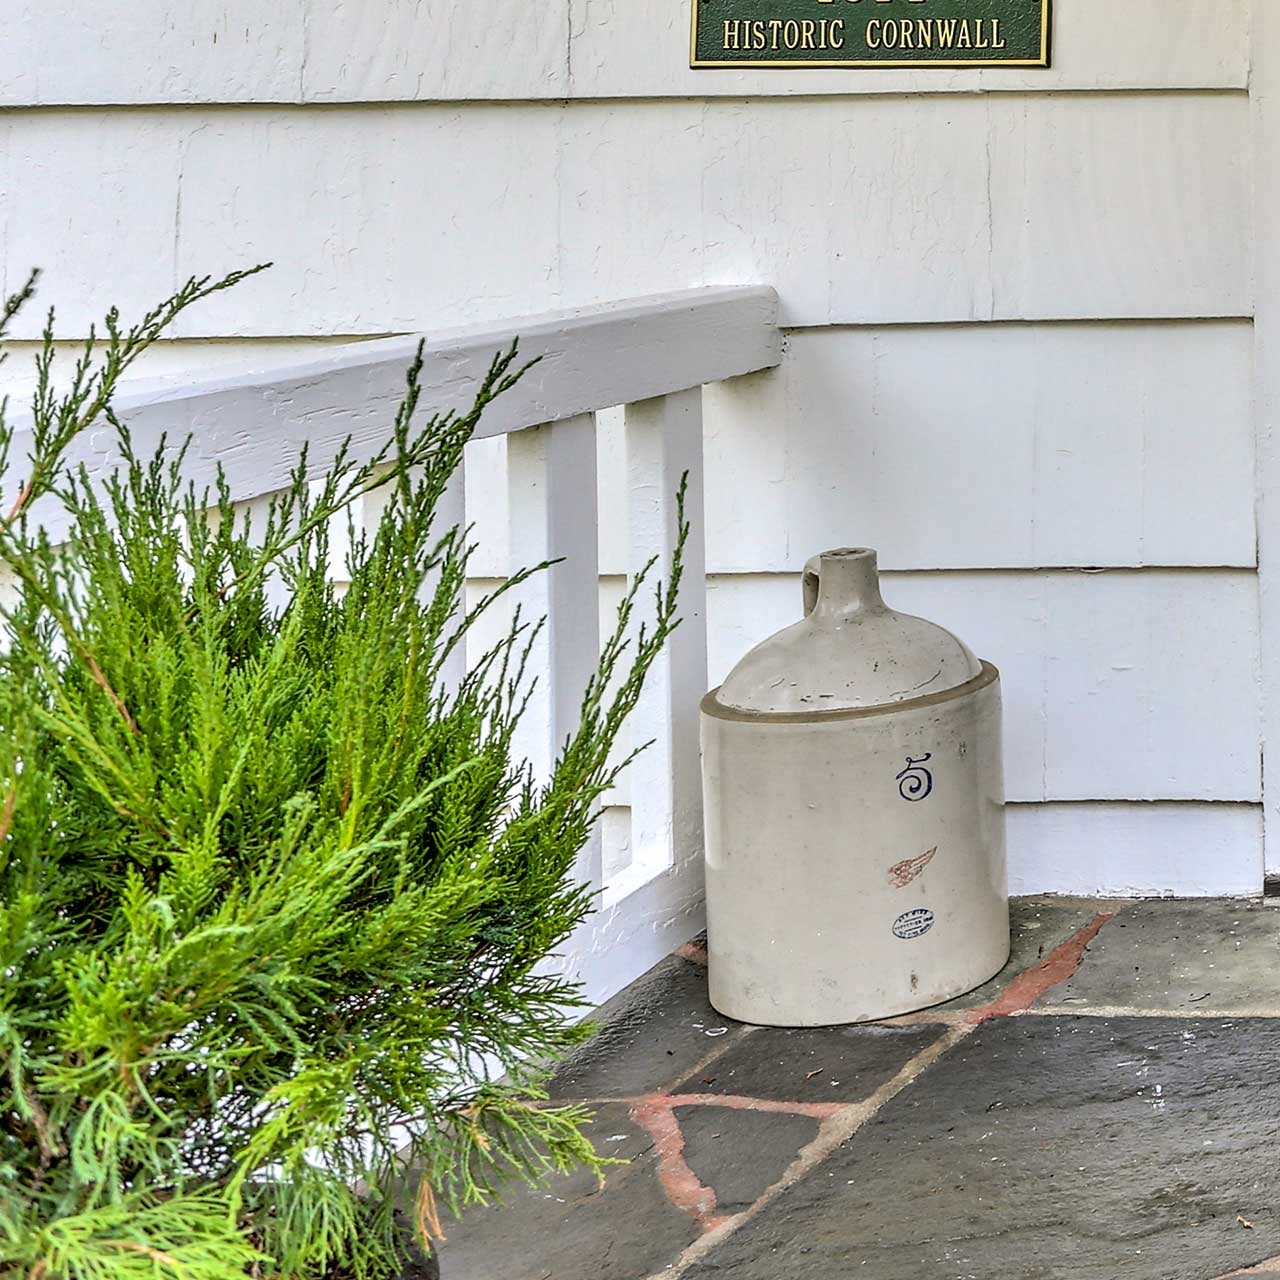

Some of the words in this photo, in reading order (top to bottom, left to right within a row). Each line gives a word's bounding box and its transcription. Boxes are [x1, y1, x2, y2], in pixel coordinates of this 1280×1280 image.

[722, 19, 846, 49] HISTORIC
[865, 19, 1006, 49] CORNWALL
[895, 752, 932, 802] 5
